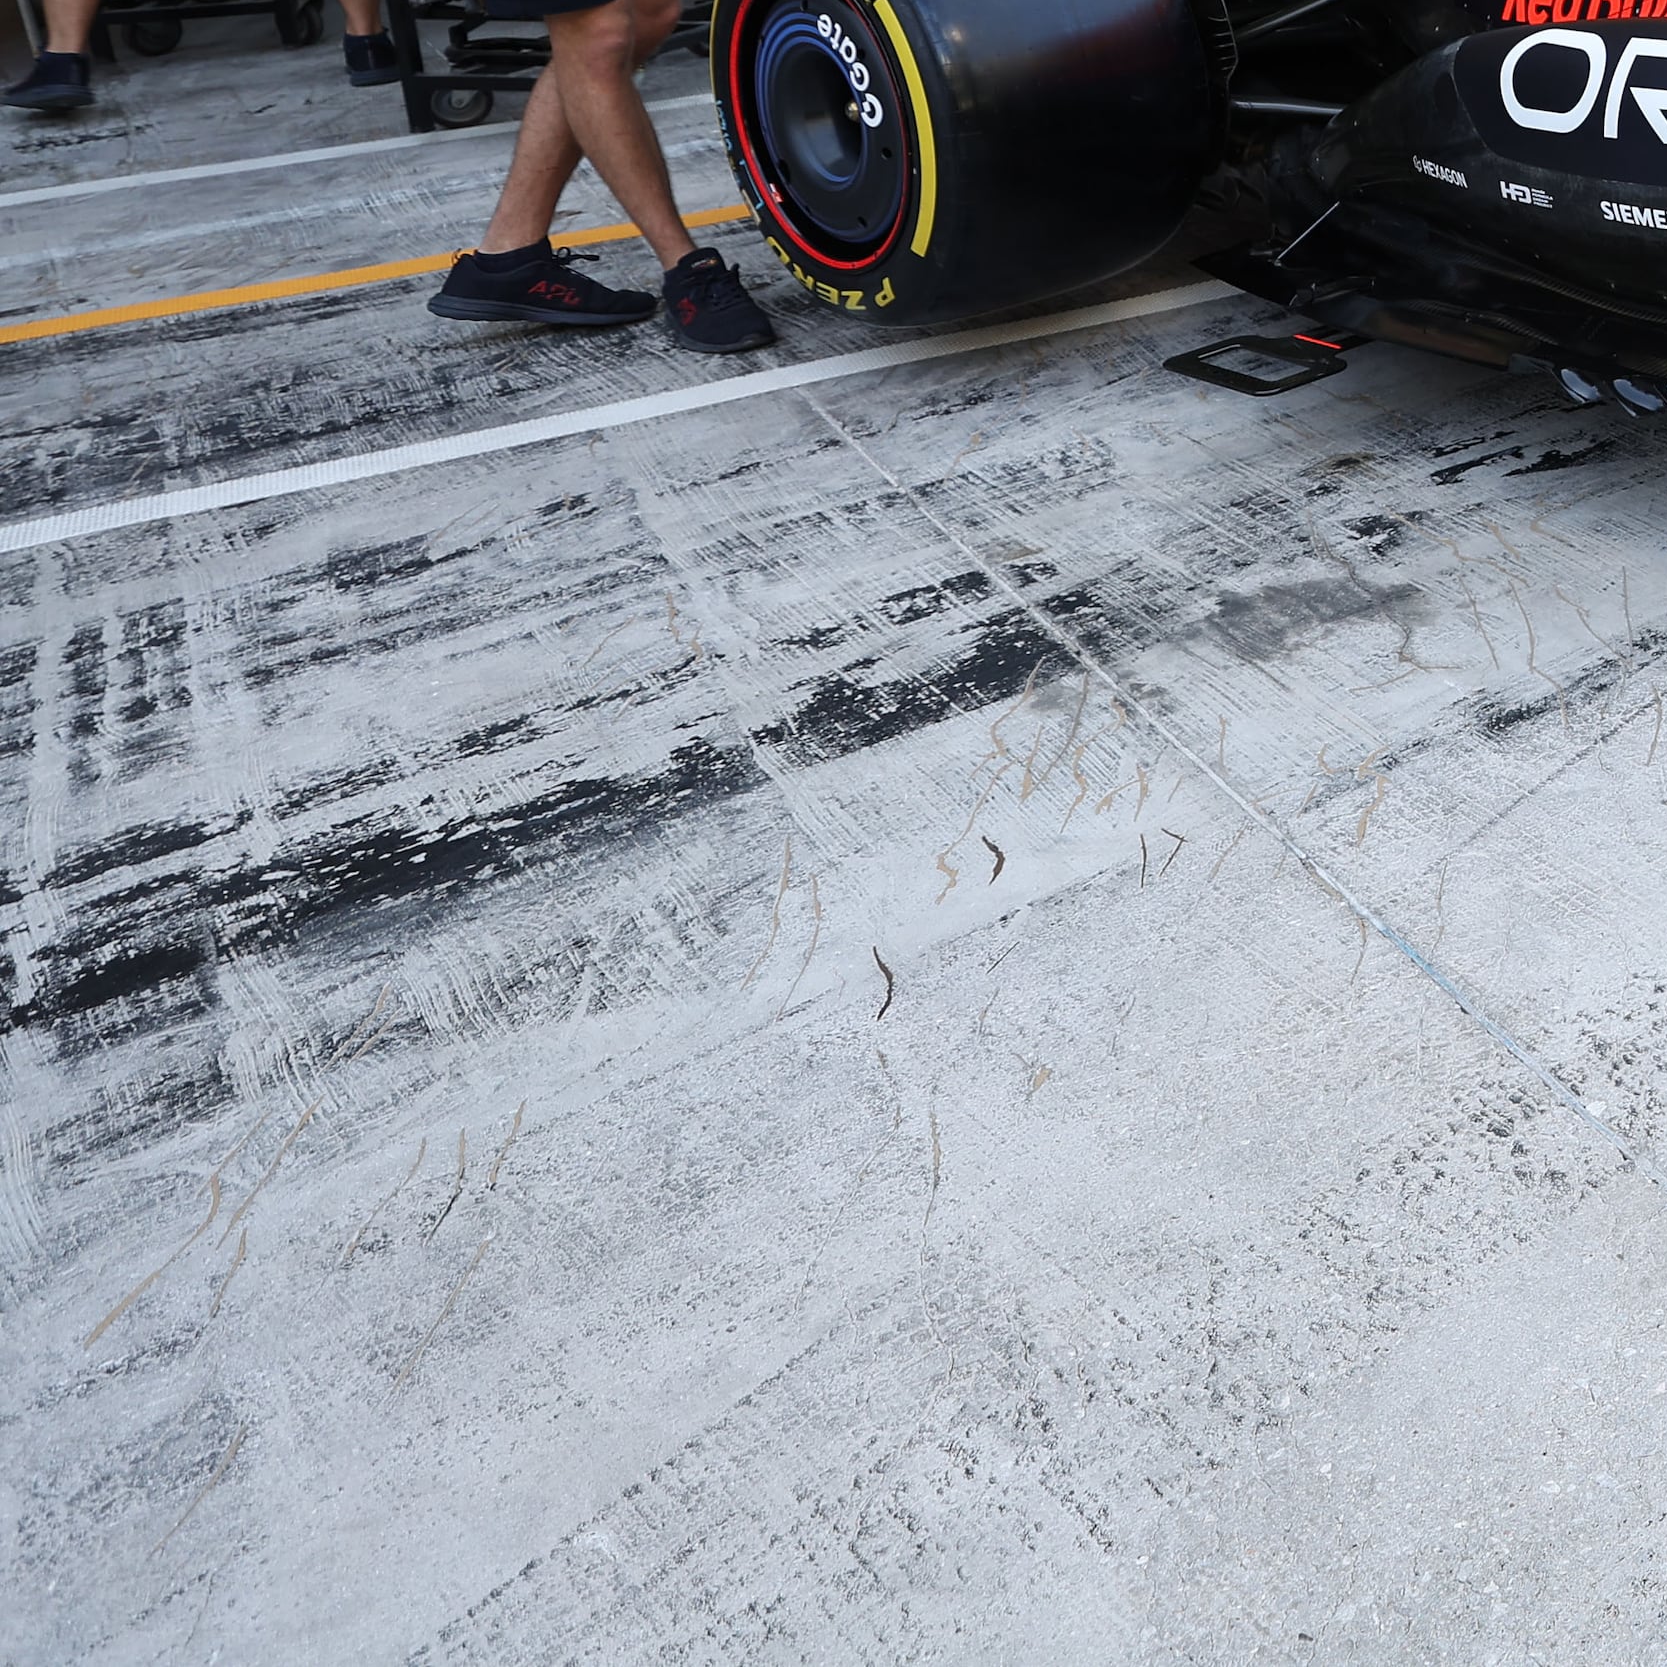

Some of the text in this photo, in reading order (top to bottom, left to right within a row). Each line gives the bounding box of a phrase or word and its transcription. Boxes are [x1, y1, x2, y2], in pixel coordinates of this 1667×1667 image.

[817, 13, 871, 94] Gate
[1422, 159, 1468, 189] HEXAGON
[874, 277, 897, 308] P
